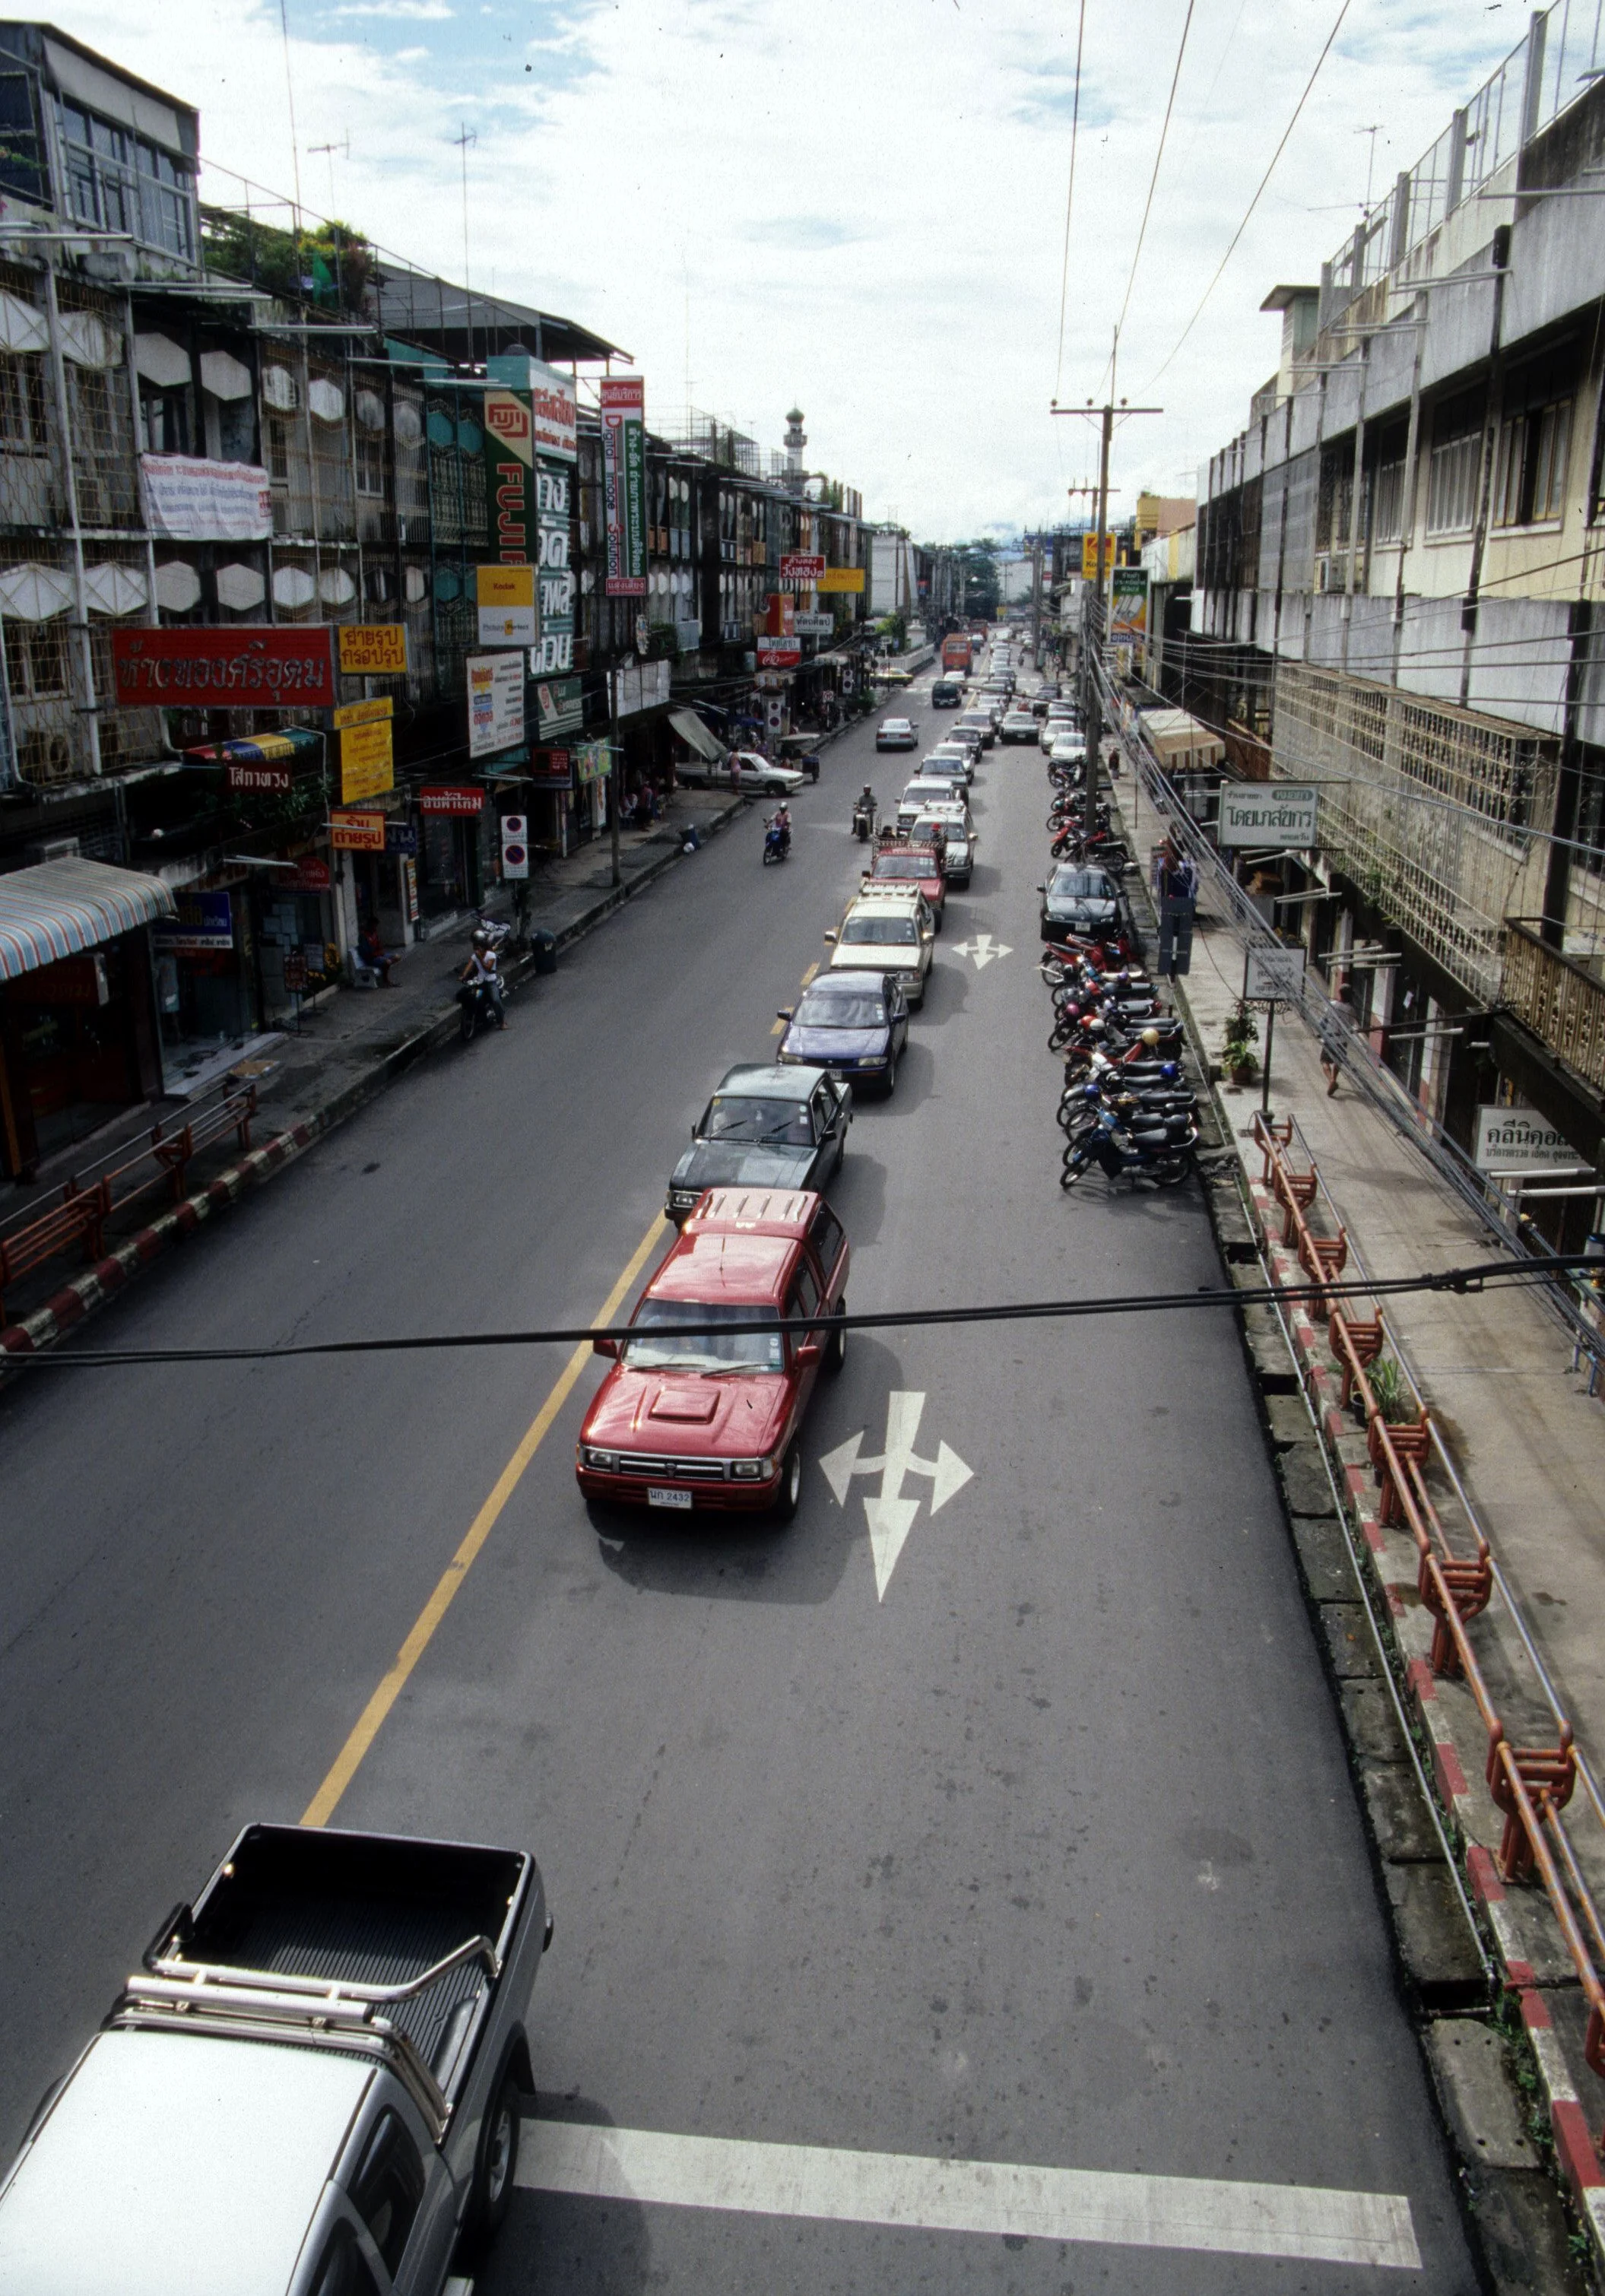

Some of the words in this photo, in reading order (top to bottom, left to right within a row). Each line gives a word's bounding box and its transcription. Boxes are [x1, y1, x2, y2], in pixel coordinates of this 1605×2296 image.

[607, 523, 624, 576] Solution
[493, 582, 515, 591] Kodak
[341, 647, 404, 668] กรอบรูป
[1226, 804, 1313, 828] โดยเภสัชกร
[335, 829, 382, 849] ถ่ายรูป
[667, 1492, 690, 1502] 2432
